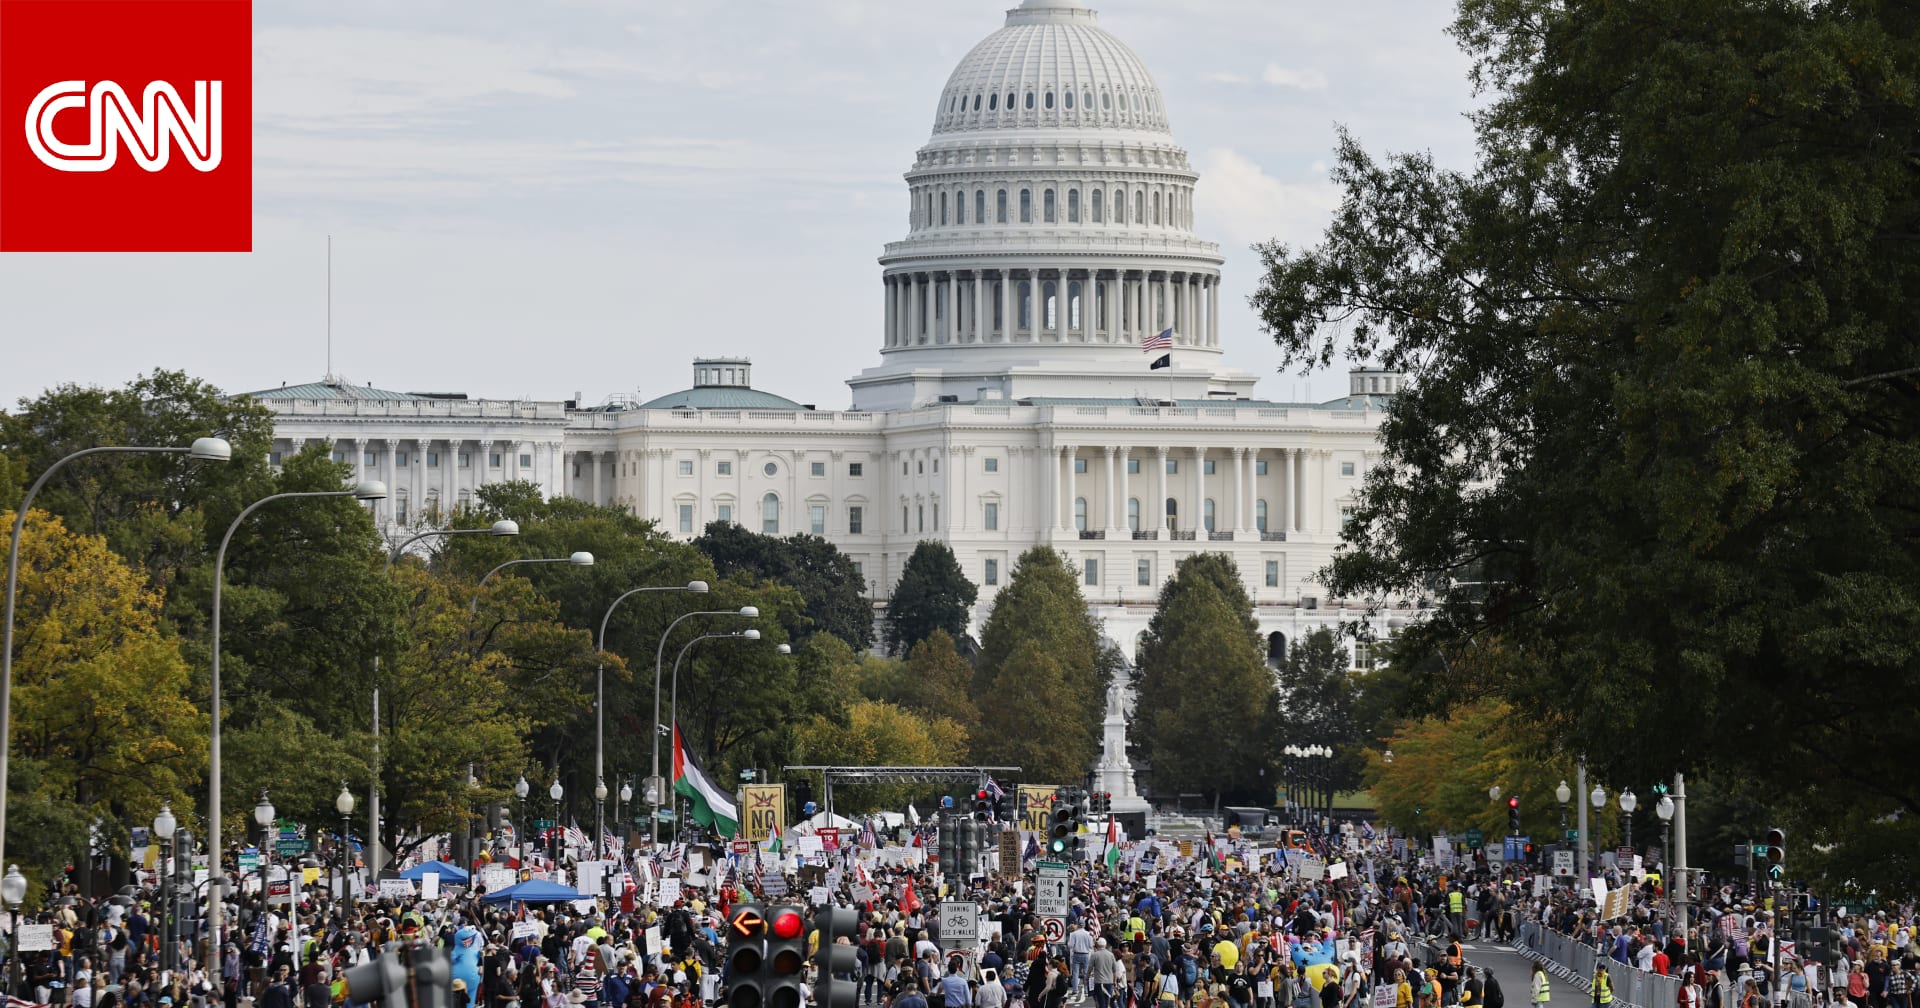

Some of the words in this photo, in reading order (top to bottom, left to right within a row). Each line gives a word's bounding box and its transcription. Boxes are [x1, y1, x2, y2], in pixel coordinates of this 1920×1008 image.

[752, 810, 775, 829] NO
[1026, 811, 1049, 830] NO
[752, 829, 771, 839] KING
